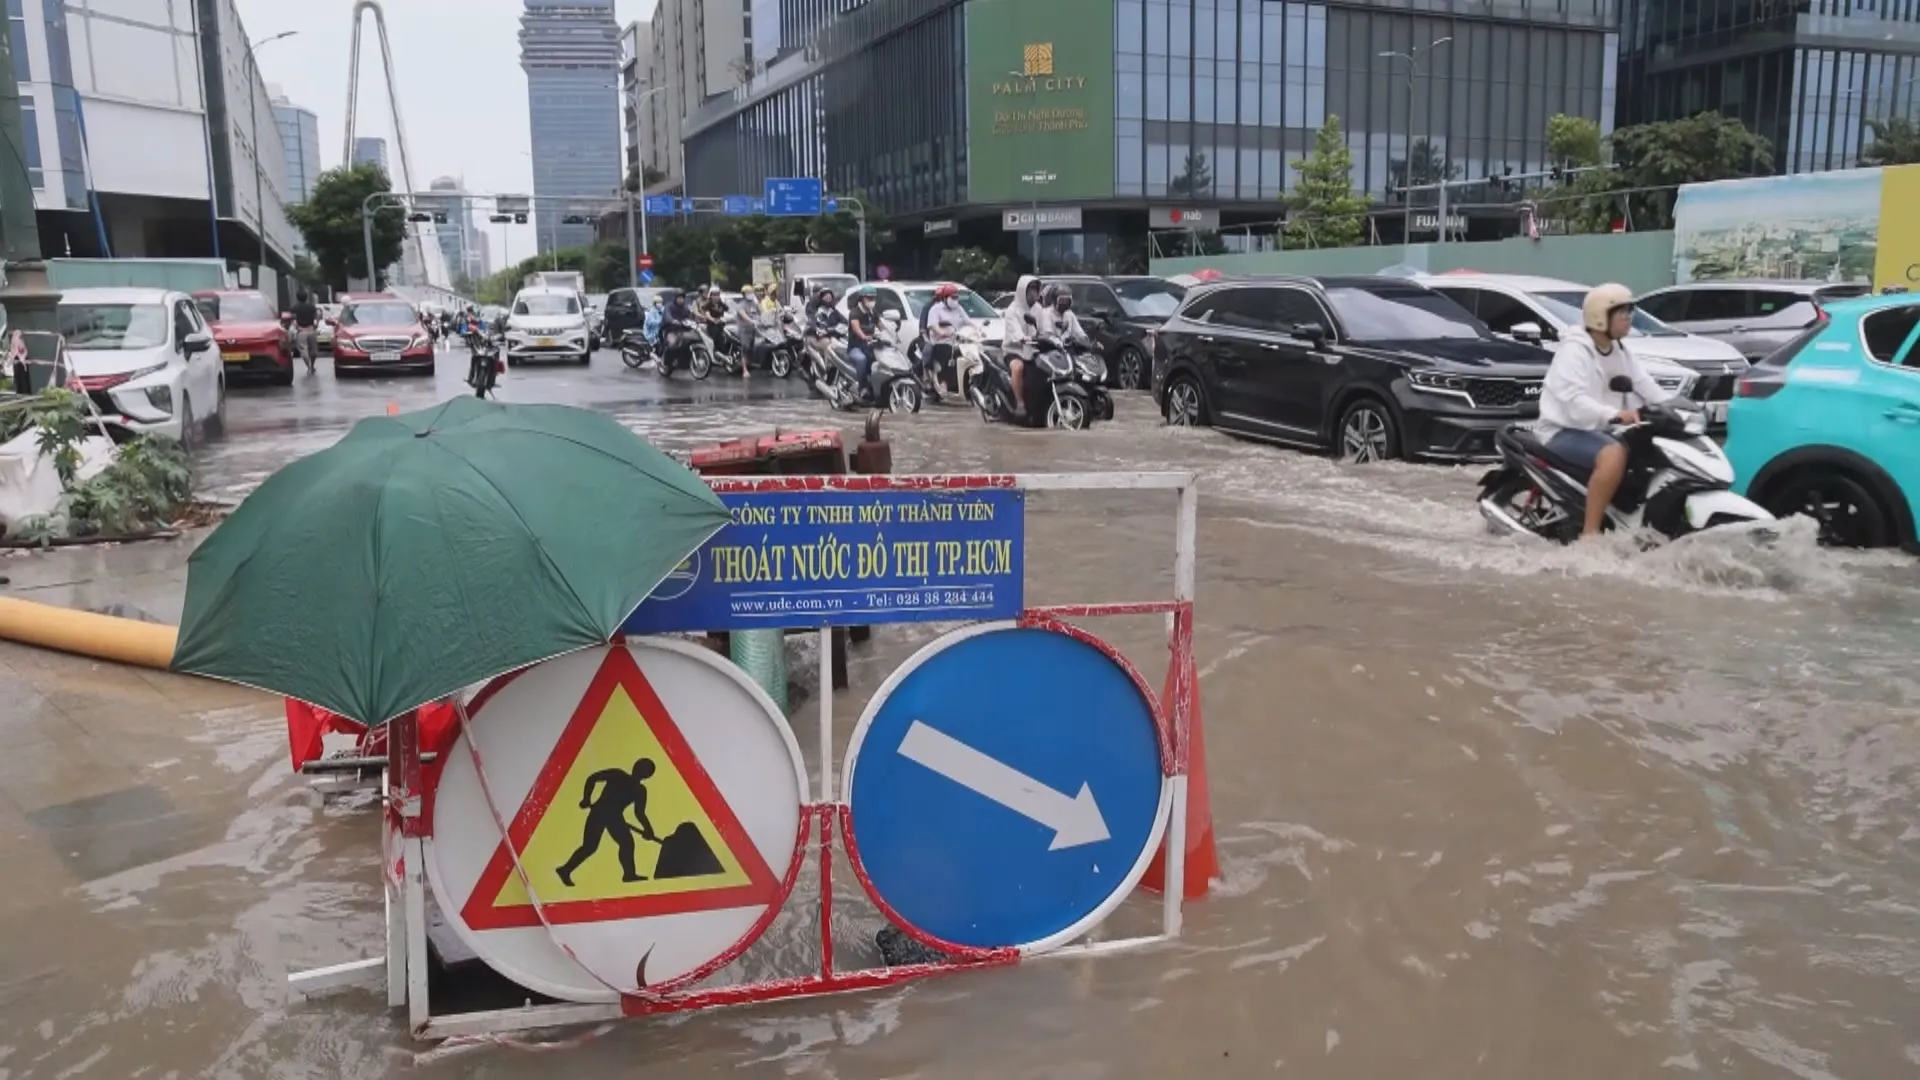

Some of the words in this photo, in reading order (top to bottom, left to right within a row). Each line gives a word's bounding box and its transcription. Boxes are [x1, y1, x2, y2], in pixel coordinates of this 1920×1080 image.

[992, 80, 1037, 95] PALM
[1045, 76, 1087, 91] CITY
[1048, 210, 1076, 222] BANK
[1183, 208, 1202, 220] nab
[1415, 215, 1465, 228] FUJILM
[730, 501, 776, 526] CÔNG
[780, 505, 802, 525] TY
[807, 505, 854, 524] TNHH
[858, 499, 894, 527] MỘT
[897, 499, 953, 523] THÀNH
[957, 497, 995, 522] VIÊN
[711, 533, 786, 583] THOÁT
[791, 531, 851, 581] NƯỚC
[857, 531, 887, 580] ĐÔ
[893, 541, 929, 585] THỊ
[935, 539, 1013, 577] TP.HCM
[730, 596, 843, 612] www.udc.com.vn
[866, 593, 892, 608] Tel:
[896, 593, 920, 606] 028
[924, 592, 940, 606] 38
[944, 591, 968, 604] 234
[971, 590, 994, 603] 444
